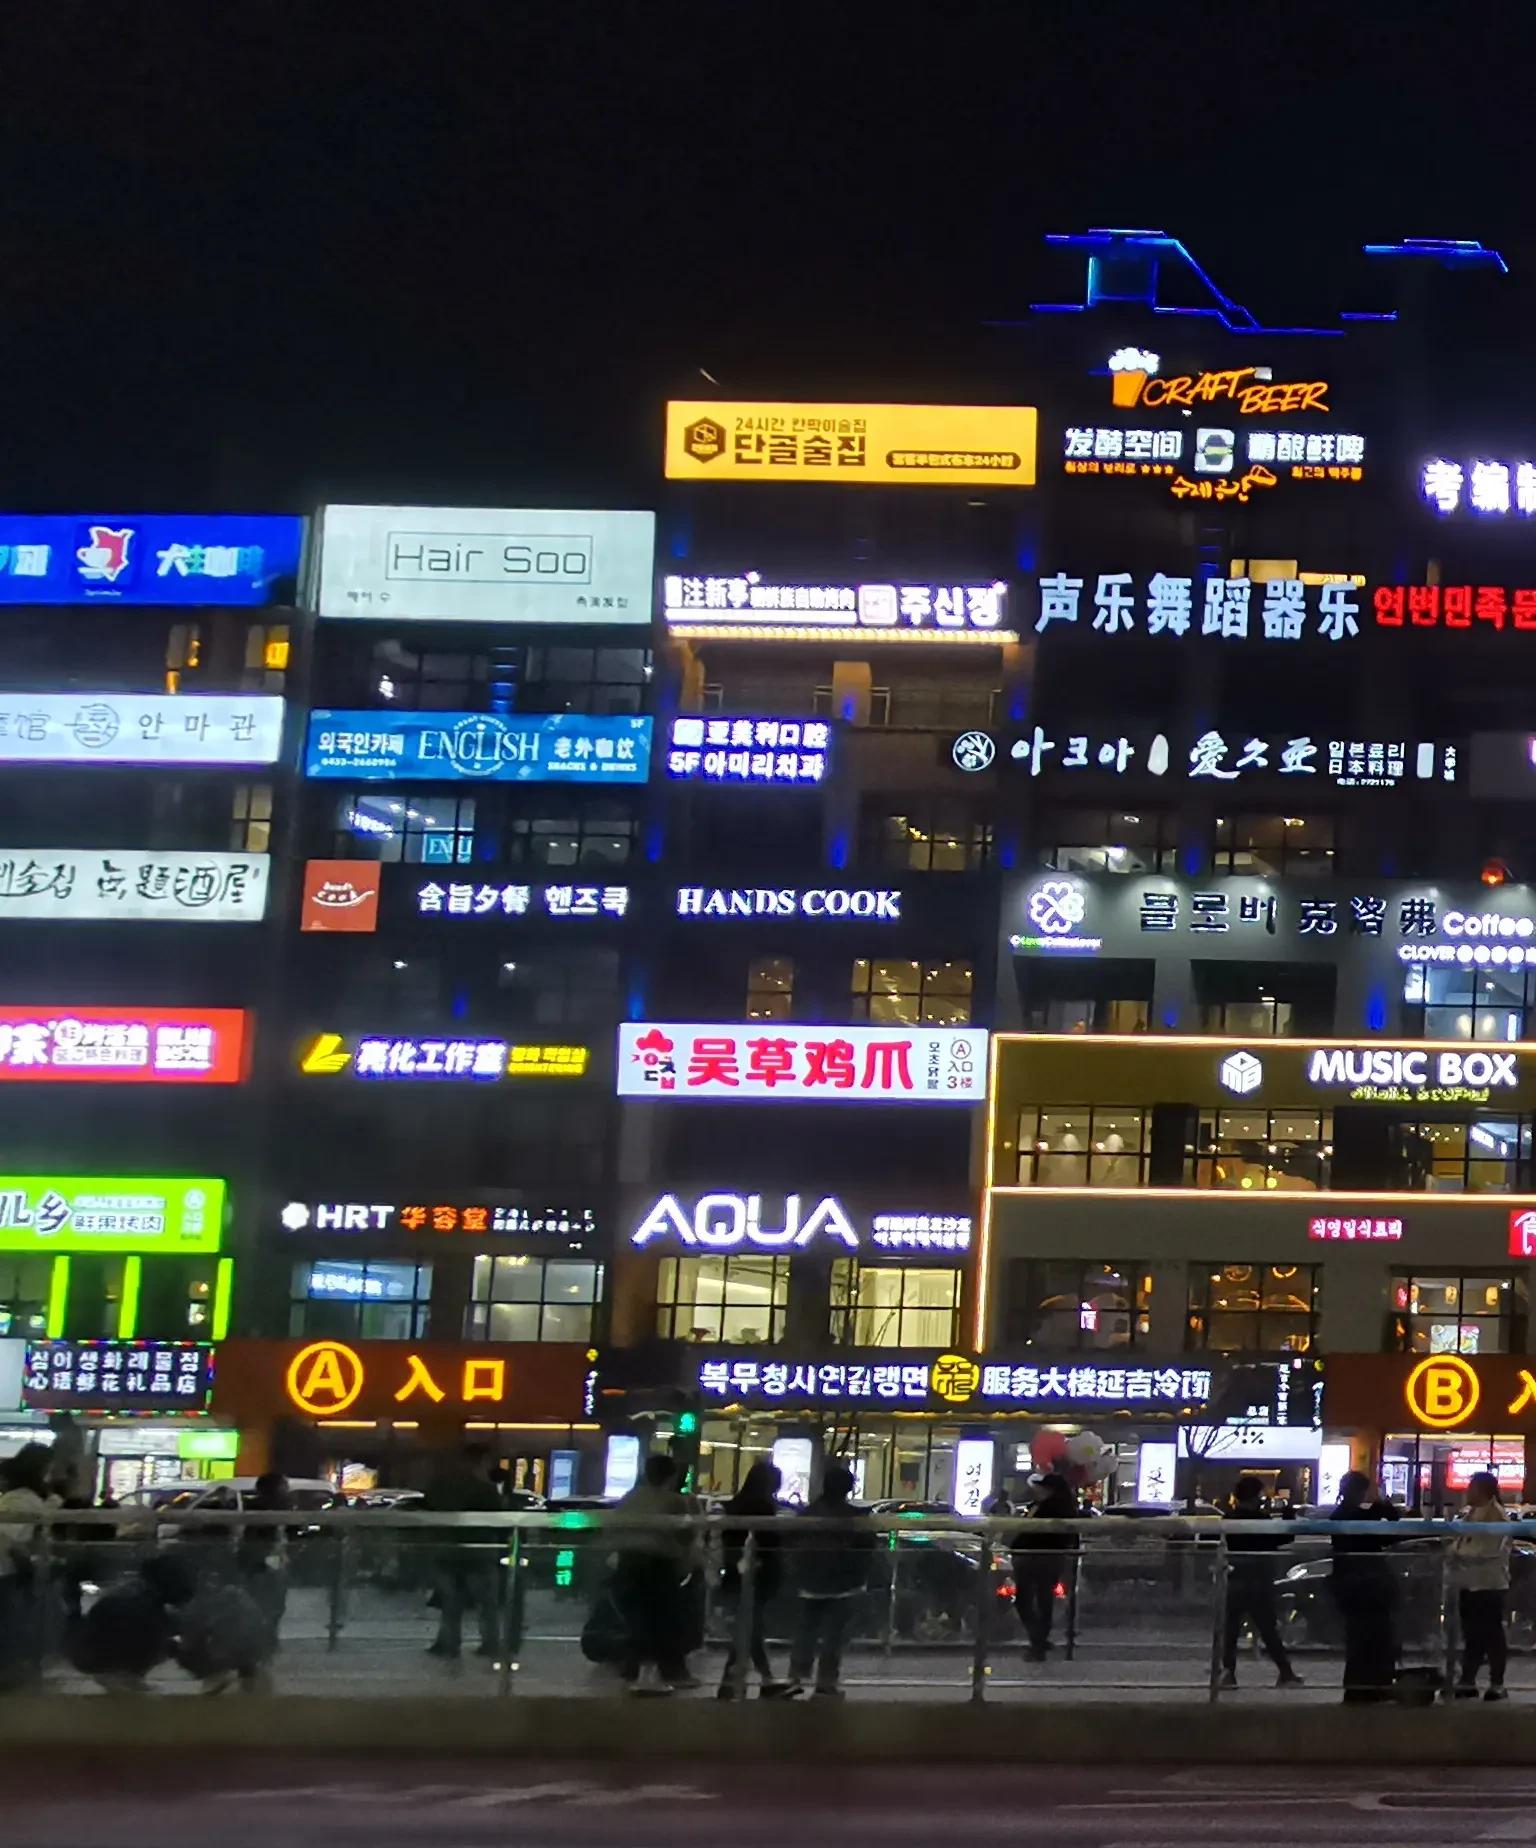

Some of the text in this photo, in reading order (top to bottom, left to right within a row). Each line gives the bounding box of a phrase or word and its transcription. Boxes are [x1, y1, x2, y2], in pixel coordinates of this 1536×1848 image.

[1143, 367, 1330, 413] CRAFT BEER
[734, 433, 867, 467] 단골술집
[1064, 428, 1183, 460] 发酵空间
[393, 543, 589, 576] Hair Soo
[1034, 572, 1361, 641] 声乐舞蹈器乐
[317, 732, 405, 756] 외국인카페
[417, 729, 541, 763] ENGLISH
[1328, 758, 1405, 777] 日本料理
[677, 886, 903, 919] HANDS COOK
[1441, 910, 1536, 939] Coffee
[1399, 945, 1456, 961] CLOVER
[686, 1036, 915, 1090] 吴草鸡爪
[947, 1060, 973, 1074] 入口
[1308, 1048, 1520, 1088] MUSIC BOX
[315, 1204, 395, 1230] HRT
[630, 1193, 860, 1248] AQUA
[394, 1354, 506, 1403] 入口
[699, 1360, 929, 1400] 복무청사연길랭면
